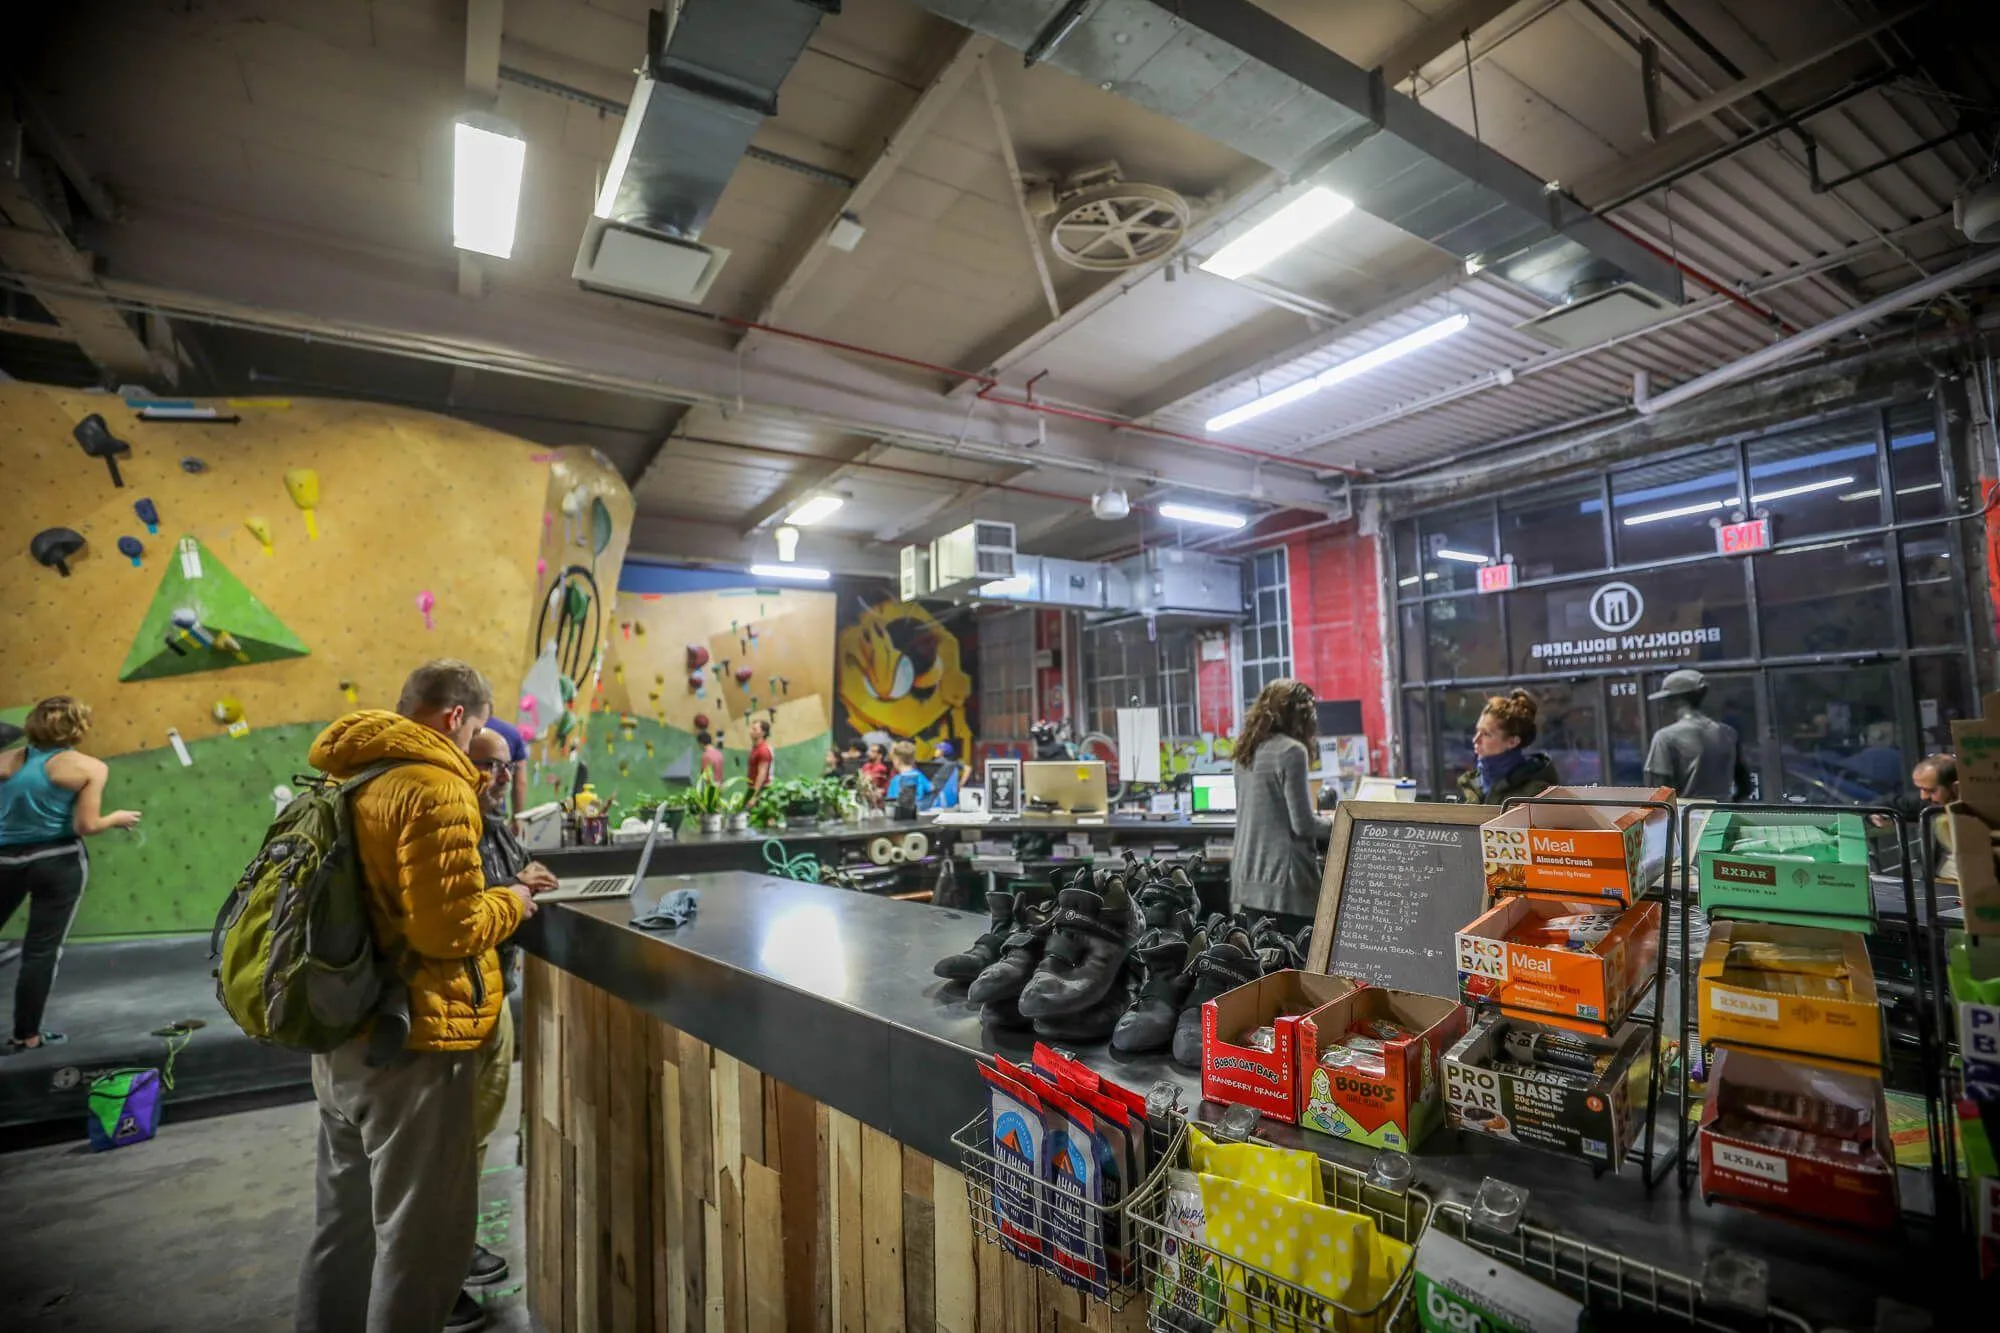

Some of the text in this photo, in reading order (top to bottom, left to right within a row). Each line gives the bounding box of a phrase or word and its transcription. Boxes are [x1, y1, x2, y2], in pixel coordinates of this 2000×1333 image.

[1723, 521, 1763, 552] EXIT
[1362, 824, 1388, 837] FOOD
[1404, 827, 1460, 842] DRINKS
[1483, 829, 1526, 845] PRO
[1485, 846, 1527, 861] BAR
[1533, 836, 1575, 853] Meal
[1536, 855, 1593, 867] Almond Crunch
[1721, 866, 1768, 880] RXBAR
[1460, 938, 1503, 959] PRO
[1461, 955, 1504, 977] BAR
[1511, 952, 1551, 973] Meal
[1213, 1055, 1280, 1084] BOBO'S OAT BARS
[1448, 1063, 1495, 1090] PRO
[1207, 1073, 1289, 1100] CRANBERRY ORANGE
[1334, 1076, 1396, 1102] BOBO'S
[1449, 1083, 1497, 1110] BAR
[1513, 1079, 1565, 1105] BASE
[1723, 1152, 1776, 1173] RXBAR
